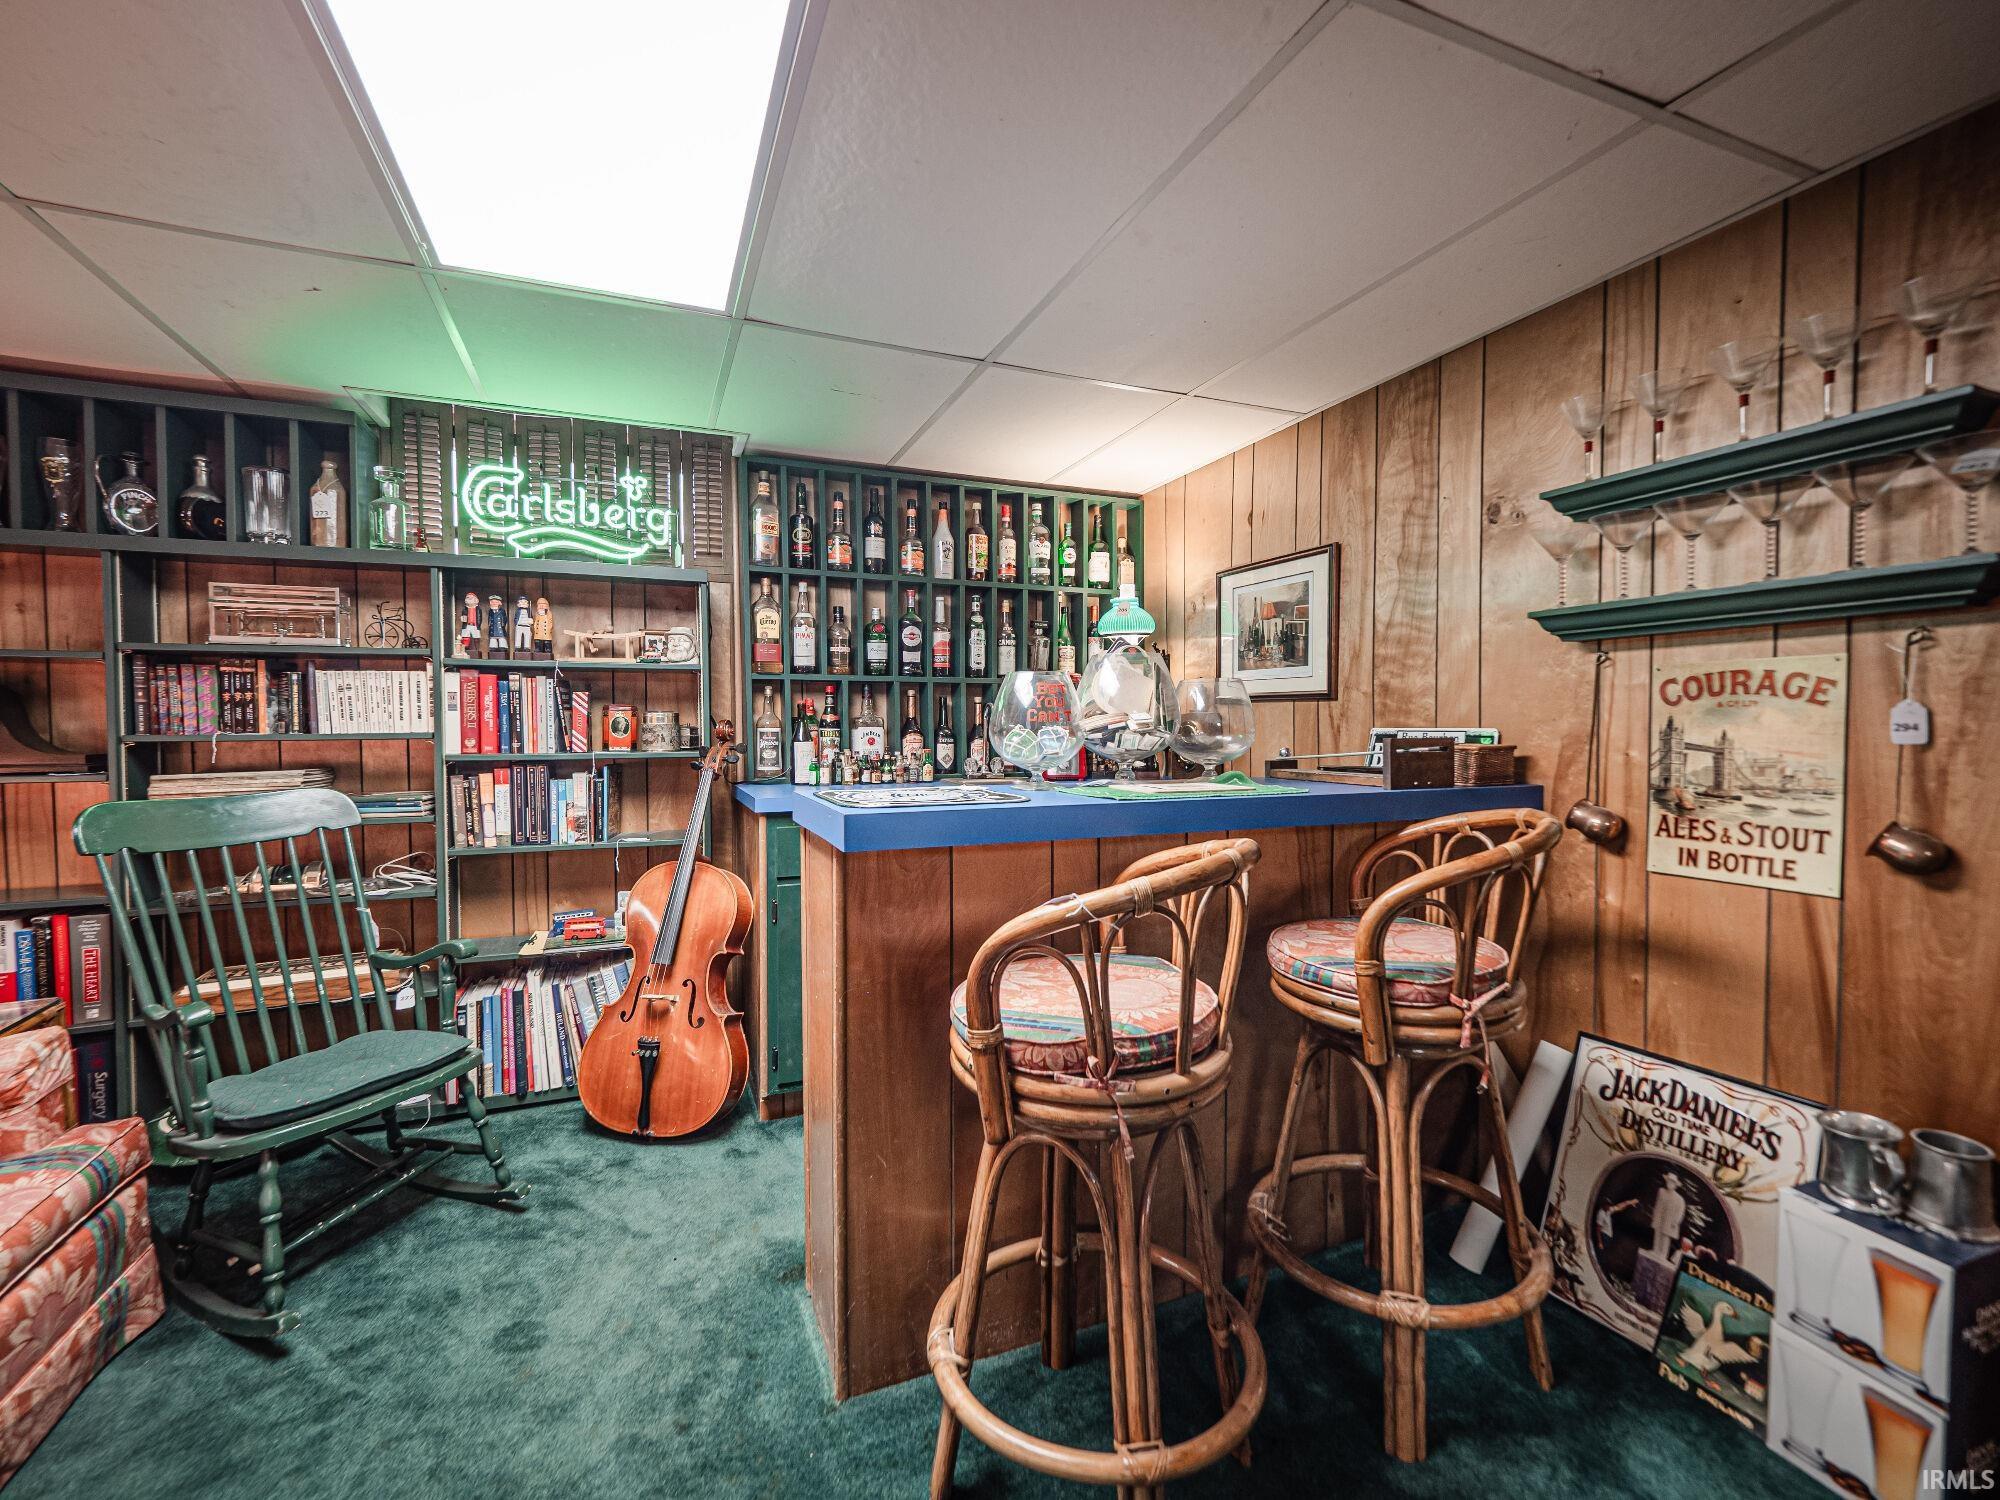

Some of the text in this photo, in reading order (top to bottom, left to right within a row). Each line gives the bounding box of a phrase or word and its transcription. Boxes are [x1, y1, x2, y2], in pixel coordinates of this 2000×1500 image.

[462, 464, 674, 546] Carlsberg
[1033, 695, 1065, 708] YOU
[1036, 681, 1065, 694] BET
[1659, 669, 1839, 707] COURAGE
[1655, 814, 1831, 854] ALES & STOUT
[1678, 847, 1797, 881] IN BOTTLE
[38, 959, 47, 985] HUMAN
[84, 950, 98, 970] THE
[84, 971, 98, 1001] HEART
[556, 1012, 564, 1040] IRELAND
[92, 1071, 108, 1119] Surgery
[1600, 1068, 1782, 1161] JACK DANIEL'S
[1652, 1107, 1711, 1136] OLD TIME
[1619, 1107, 1745, 1171] DISTILLERY
[1687, 1261, 1752, 1304] Drunken
[1658, 1362, 1690, 1392] Pub
